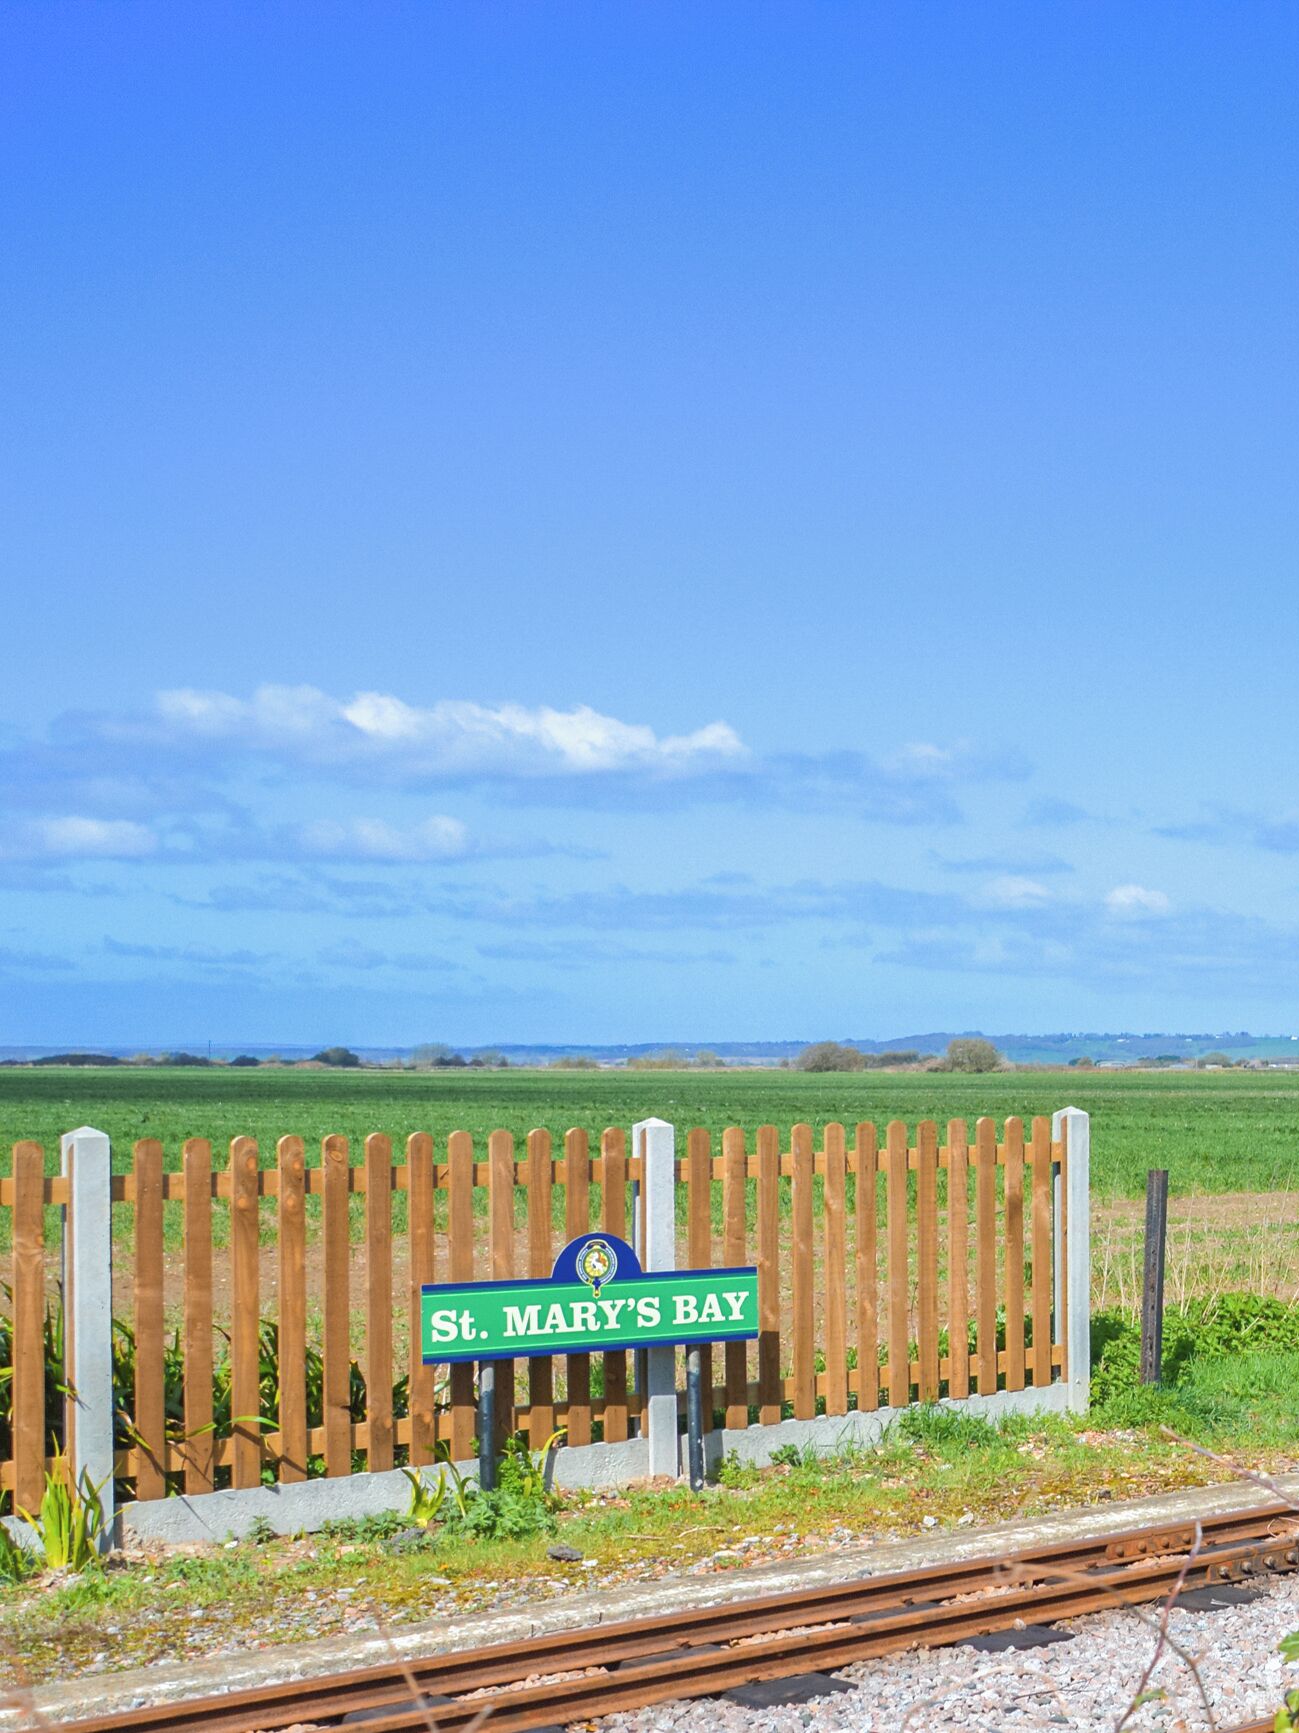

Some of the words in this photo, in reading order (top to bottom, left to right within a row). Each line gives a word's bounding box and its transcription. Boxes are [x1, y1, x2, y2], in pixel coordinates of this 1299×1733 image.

[431, 1309, 489, 1343] St.
[502, 1296, 661, 1338] MARY'S
[672, 1291, 750, 1326] BAY
